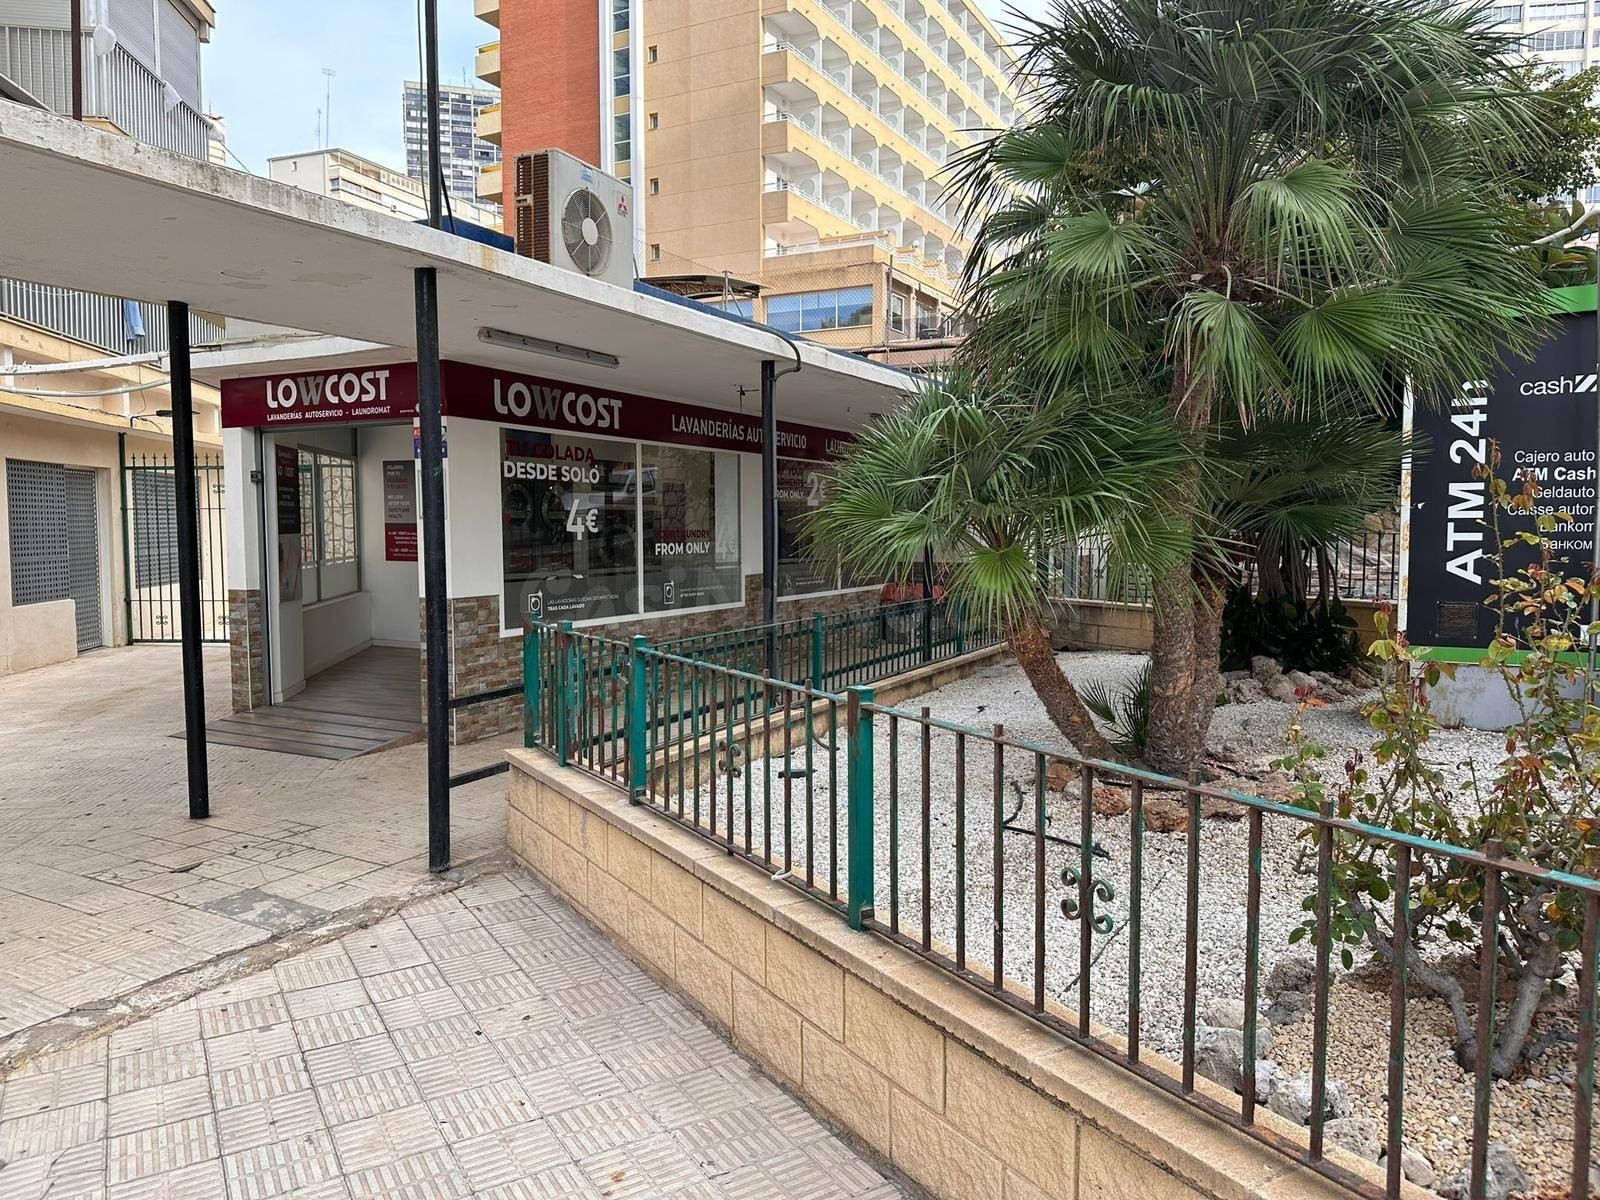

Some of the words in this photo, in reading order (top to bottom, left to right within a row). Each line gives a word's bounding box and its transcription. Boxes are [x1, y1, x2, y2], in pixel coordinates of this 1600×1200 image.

[266, 410, 303, 422] LAVANDERÍAS
[305, 409, 343, 419] AUTOSERVICIO
[352, 406, 391, 416] LAUNDROMAT
[671, 414, 745, 441] LAVANDERÍAS
[746, 430, 807, 449] AUTERVICIO
[533, 442, 595, 463] COLADA
[1514, 450, 1560, 466] Cajero
[503, 461, 558, 481] DESDE
[1554, 466, 1597, 481] Cash
[776, 490, 789, 499] ROM
[1446, 482, 1485, 585] ATM
[655, 542, 684, 556] FROM
[686, 541, 711, 555] ONLY
